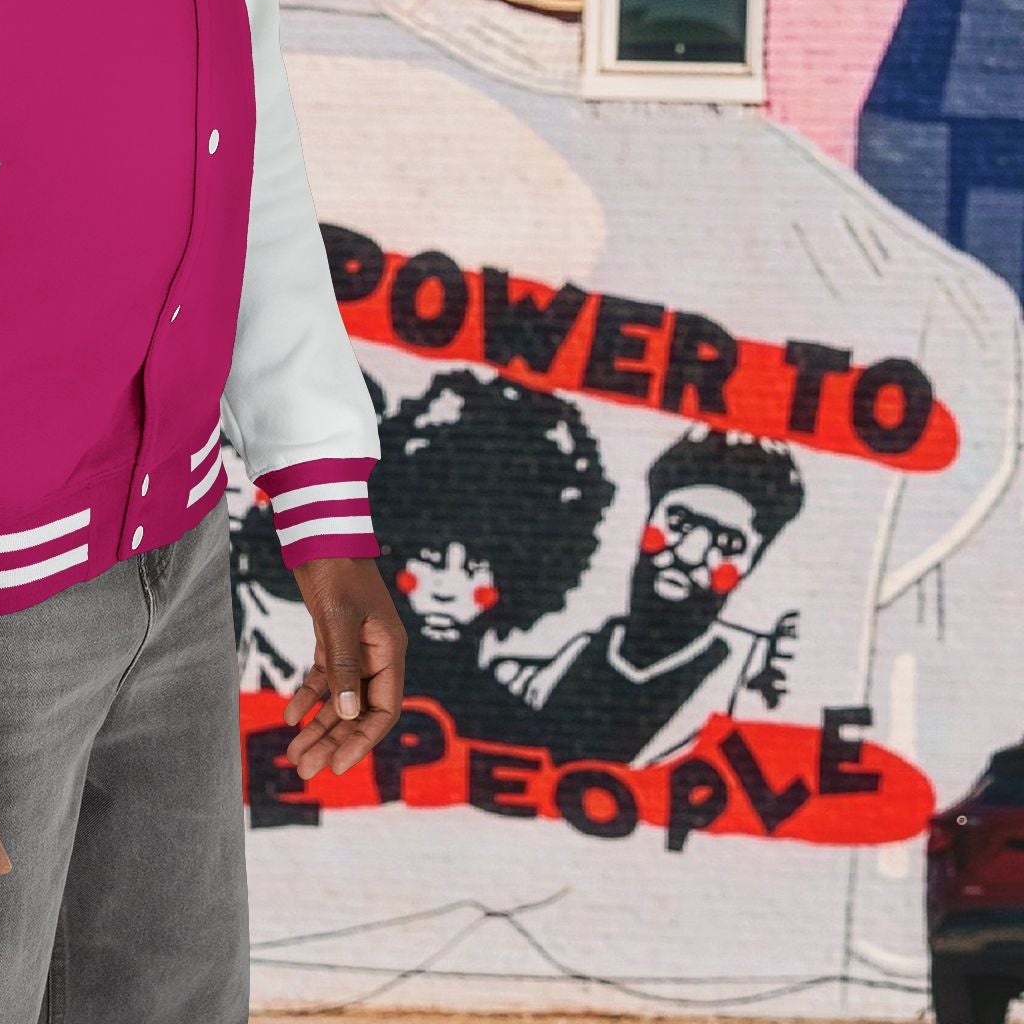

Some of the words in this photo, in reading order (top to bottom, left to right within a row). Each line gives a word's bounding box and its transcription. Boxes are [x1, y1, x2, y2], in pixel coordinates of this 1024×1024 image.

[319, 223, 738, 416] POWER
[784, 339, 933, 455] TO
[372, 706, 883, 852] PEOPLE
